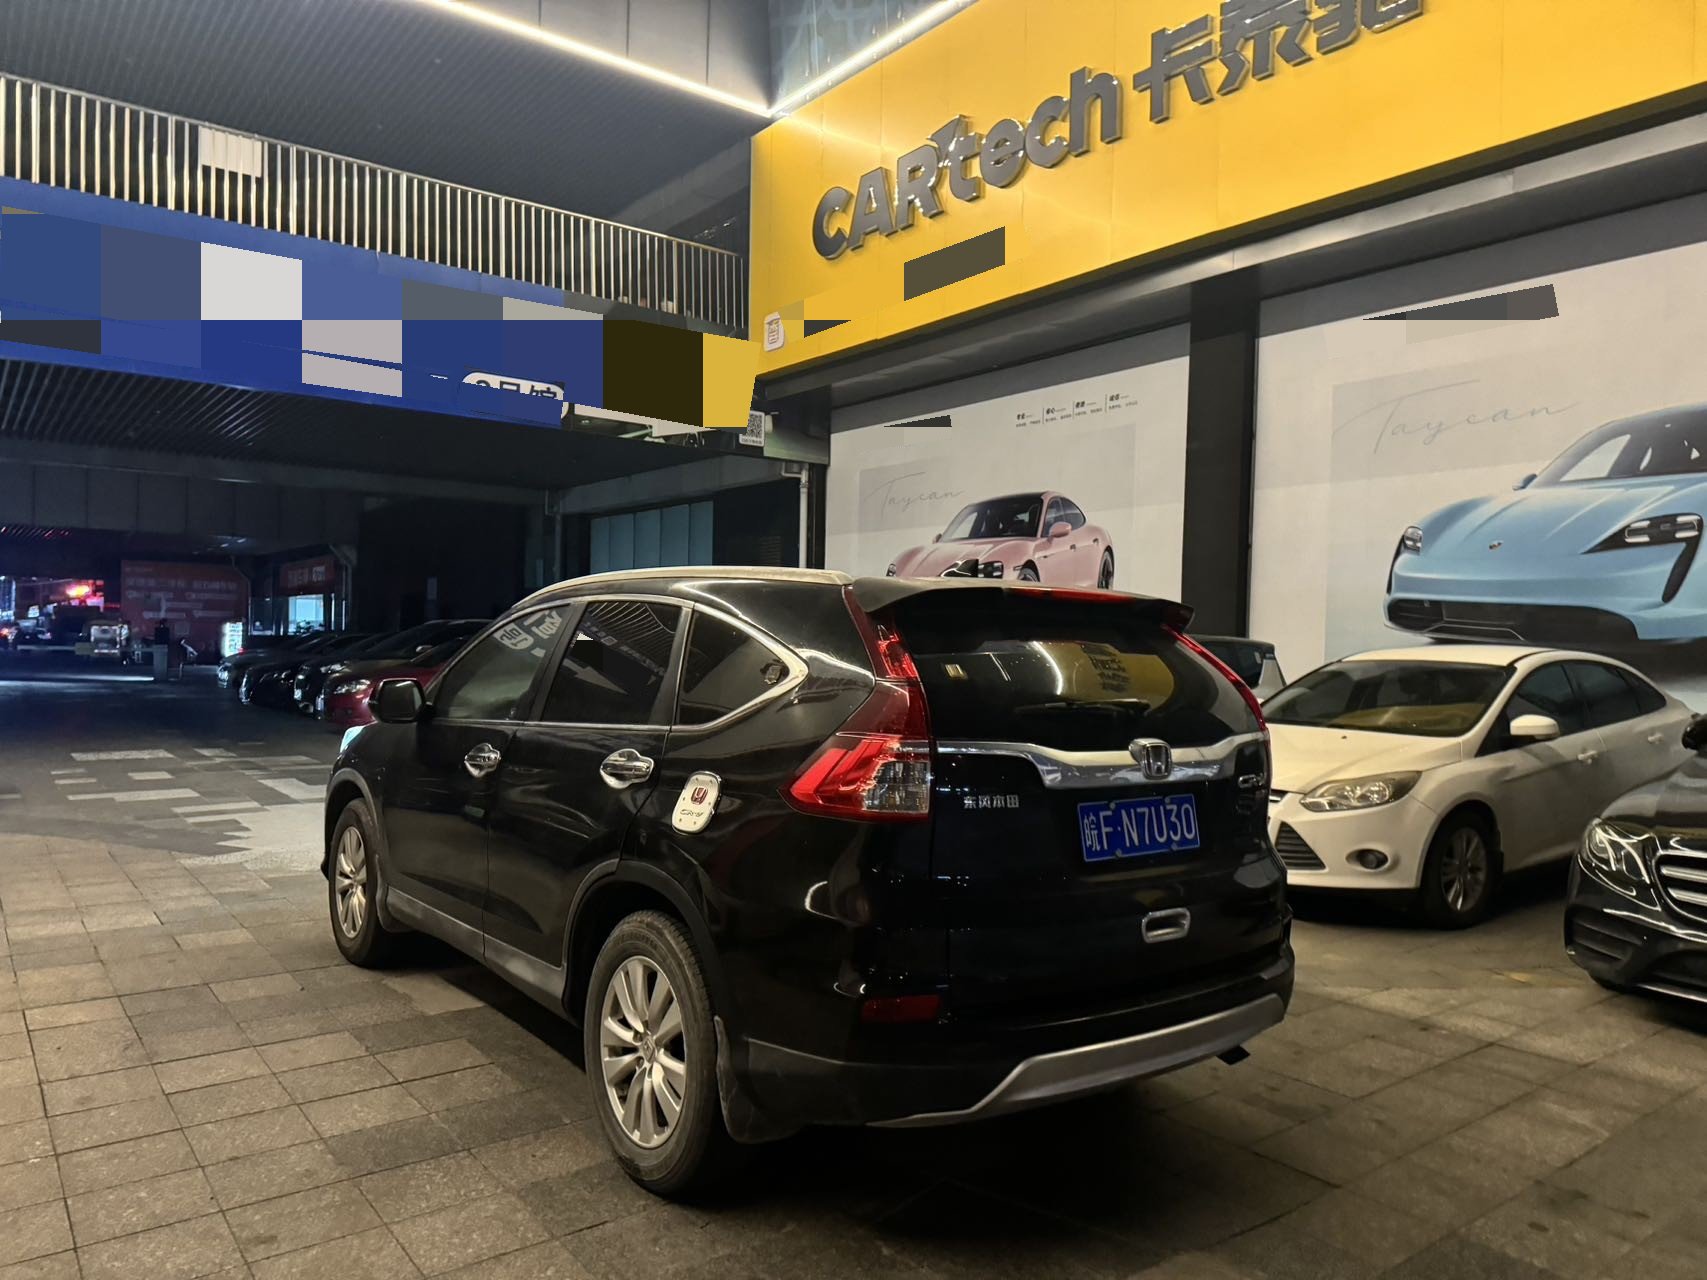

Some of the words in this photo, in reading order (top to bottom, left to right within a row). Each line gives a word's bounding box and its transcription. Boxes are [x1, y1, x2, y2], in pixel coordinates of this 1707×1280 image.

[812, 66, 1122, 260] CARtech
[1332, 379, 1579, 454] Taycan
[866, 471, 964, 520] Taycan
[963, 794, 1019, 809] 东风本田
